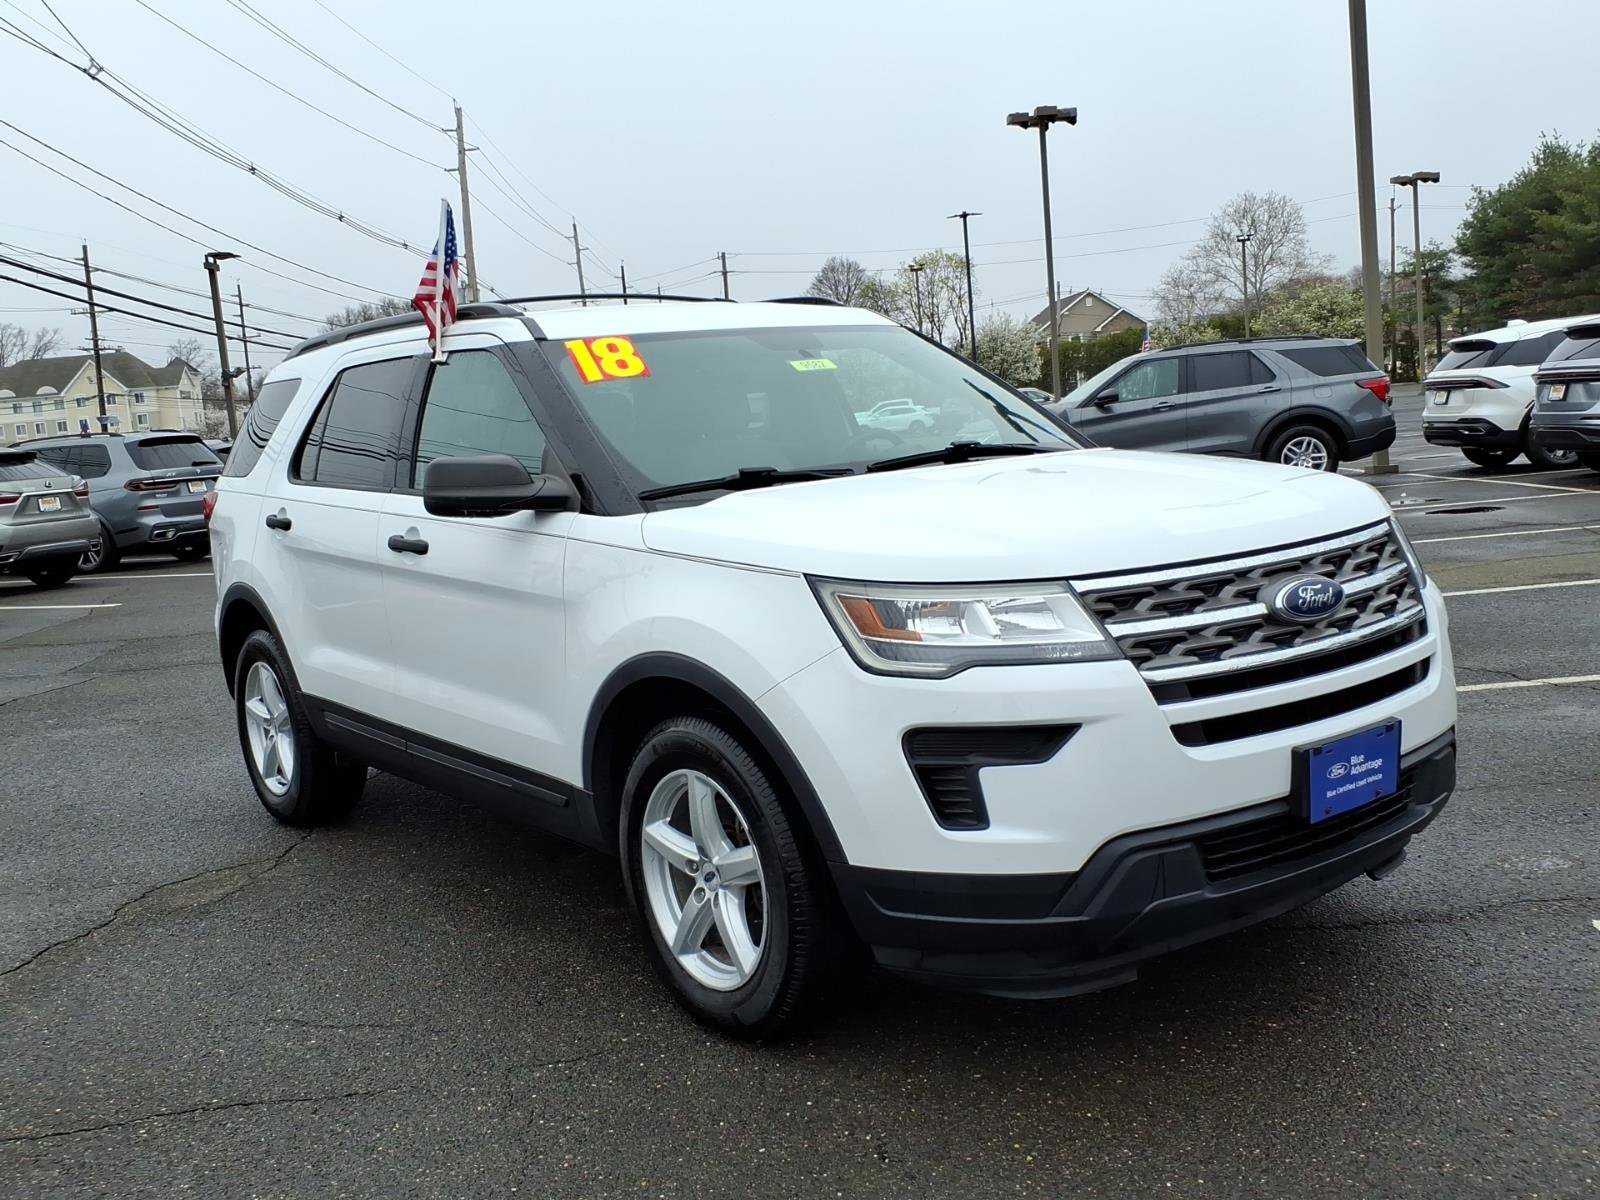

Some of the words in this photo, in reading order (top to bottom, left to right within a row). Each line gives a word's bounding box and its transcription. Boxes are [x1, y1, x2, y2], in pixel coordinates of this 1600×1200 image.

[564, 337, 645, 382] 18
[1298, 583, 1335, 611] Ford
[1350, 758, 1383, 775] Advantage
[1351, 755, 1365, 765] Blue
[1329, 764, 1347, 777] Ford
[1326, 790, 1336, 798] Blue
[1337, 783, 1355, 794] Certified
